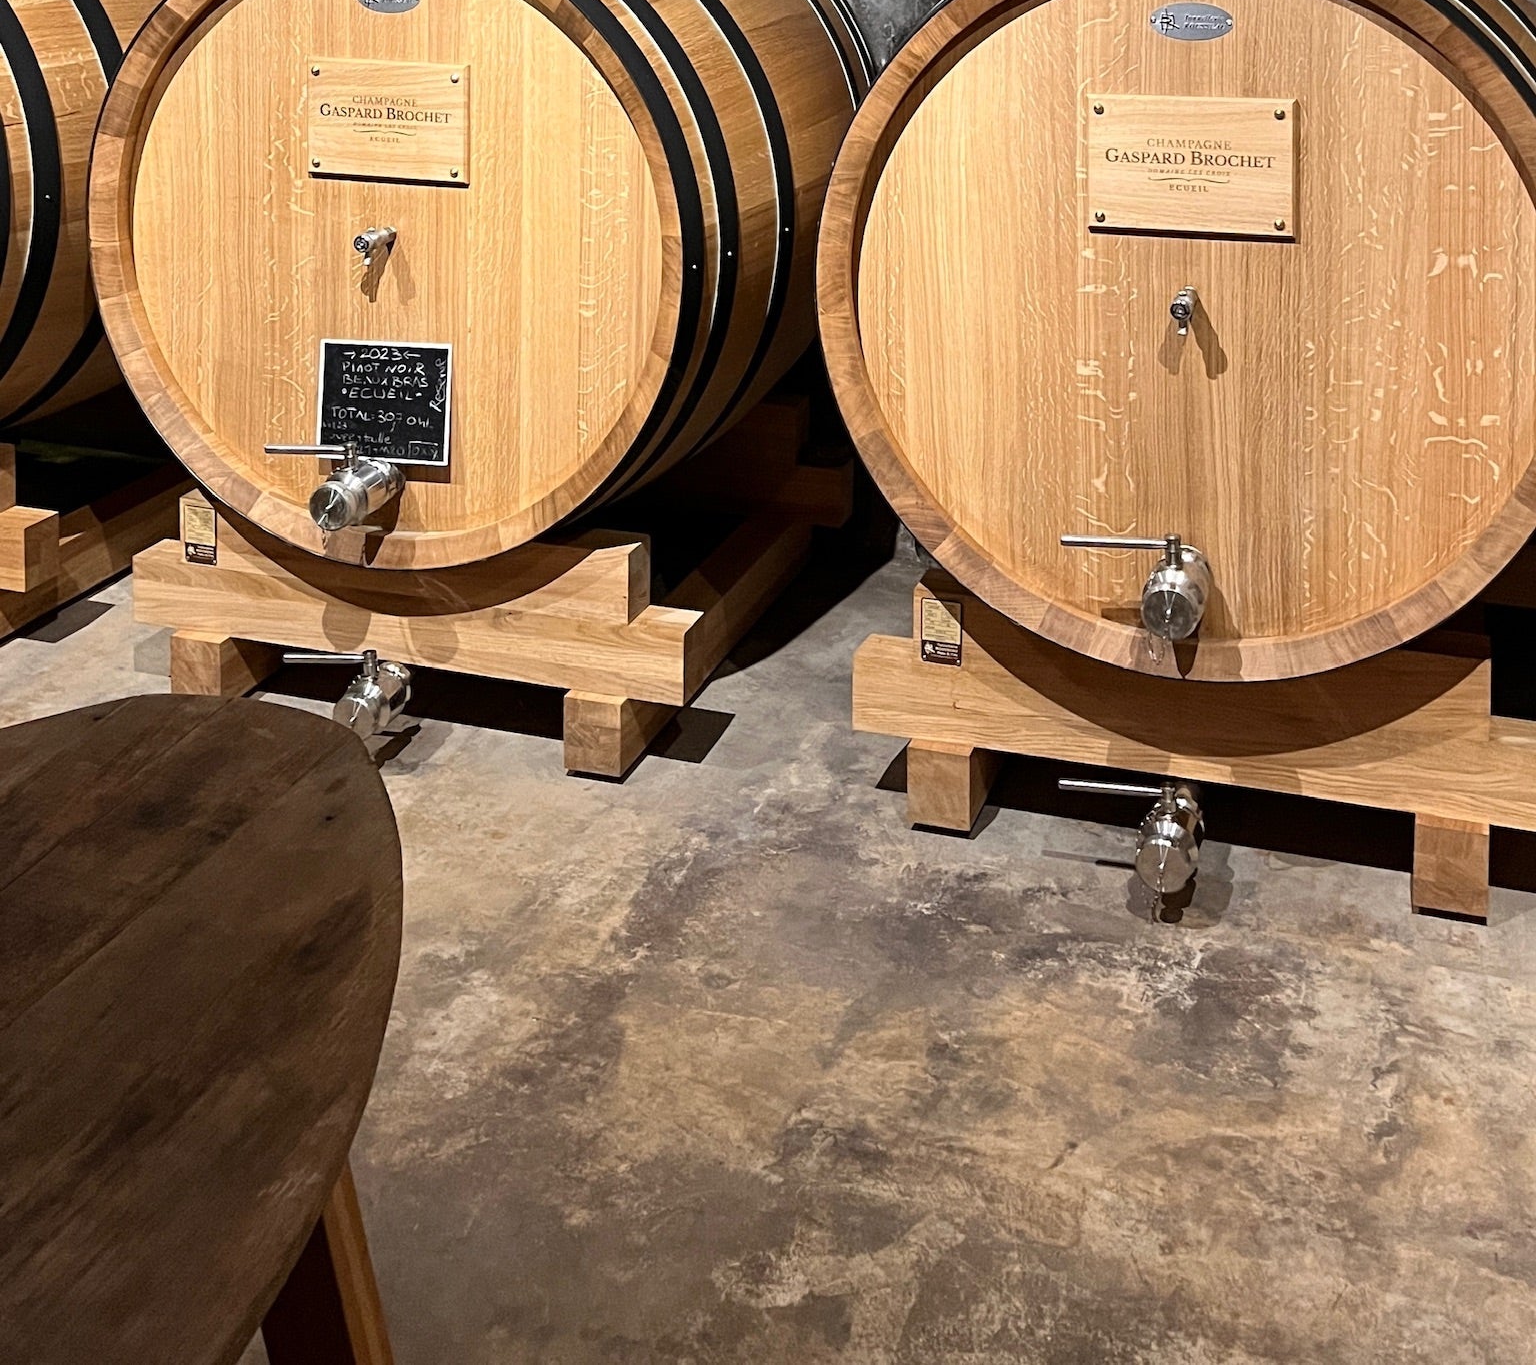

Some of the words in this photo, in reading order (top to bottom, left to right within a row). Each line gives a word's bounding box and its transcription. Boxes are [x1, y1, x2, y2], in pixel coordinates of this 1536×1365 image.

[352, 95, 417, 107] CHAMPAGNE
[320, 103, 383, 119] GASPARD
[386, 107, 451, 124] BROCHET
[1146, 138, 1232, 151] CHAMPAGNE
[1105, 148, 1186, 165] GASPARD
[1190, 150, 1276, 169] BROCHET
[1169, 184, 1209, 193] ECUEIL
[360, 348, 403, 361] 2023
[342, 361, 380, 373] PINOT
